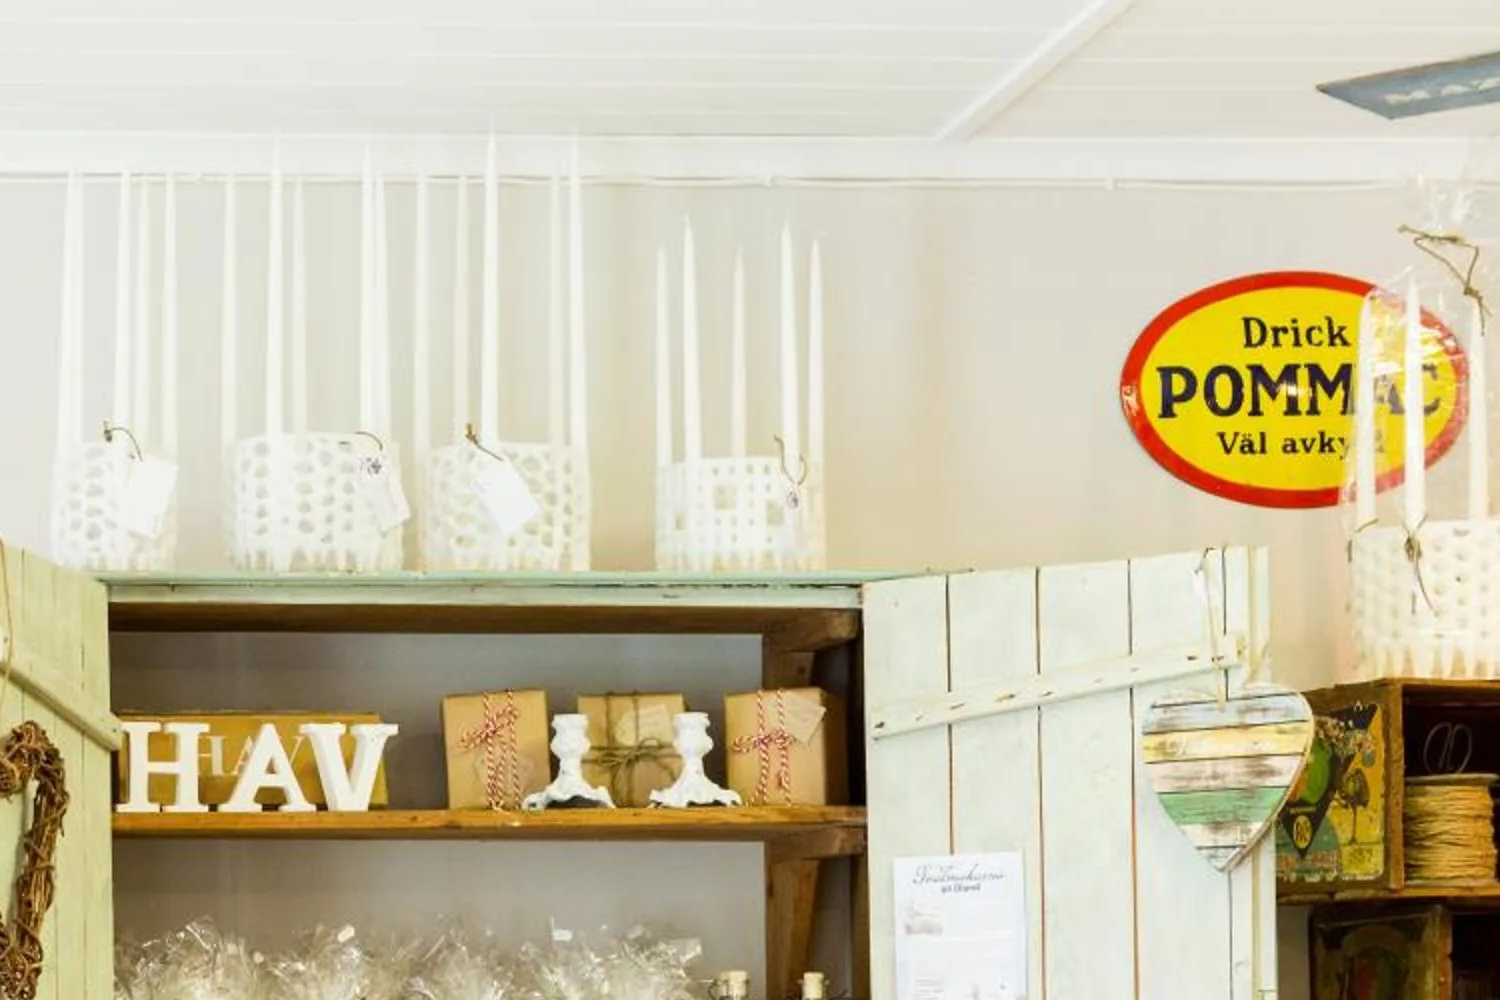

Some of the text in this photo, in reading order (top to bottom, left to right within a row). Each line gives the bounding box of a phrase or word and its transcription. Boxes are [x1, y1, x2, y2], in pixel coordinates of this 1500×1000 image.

[1243, 317, 1352, 349] Drick
[1217, 431, 1268, 455] Väl
[116, 721, 399, 812] HAV
